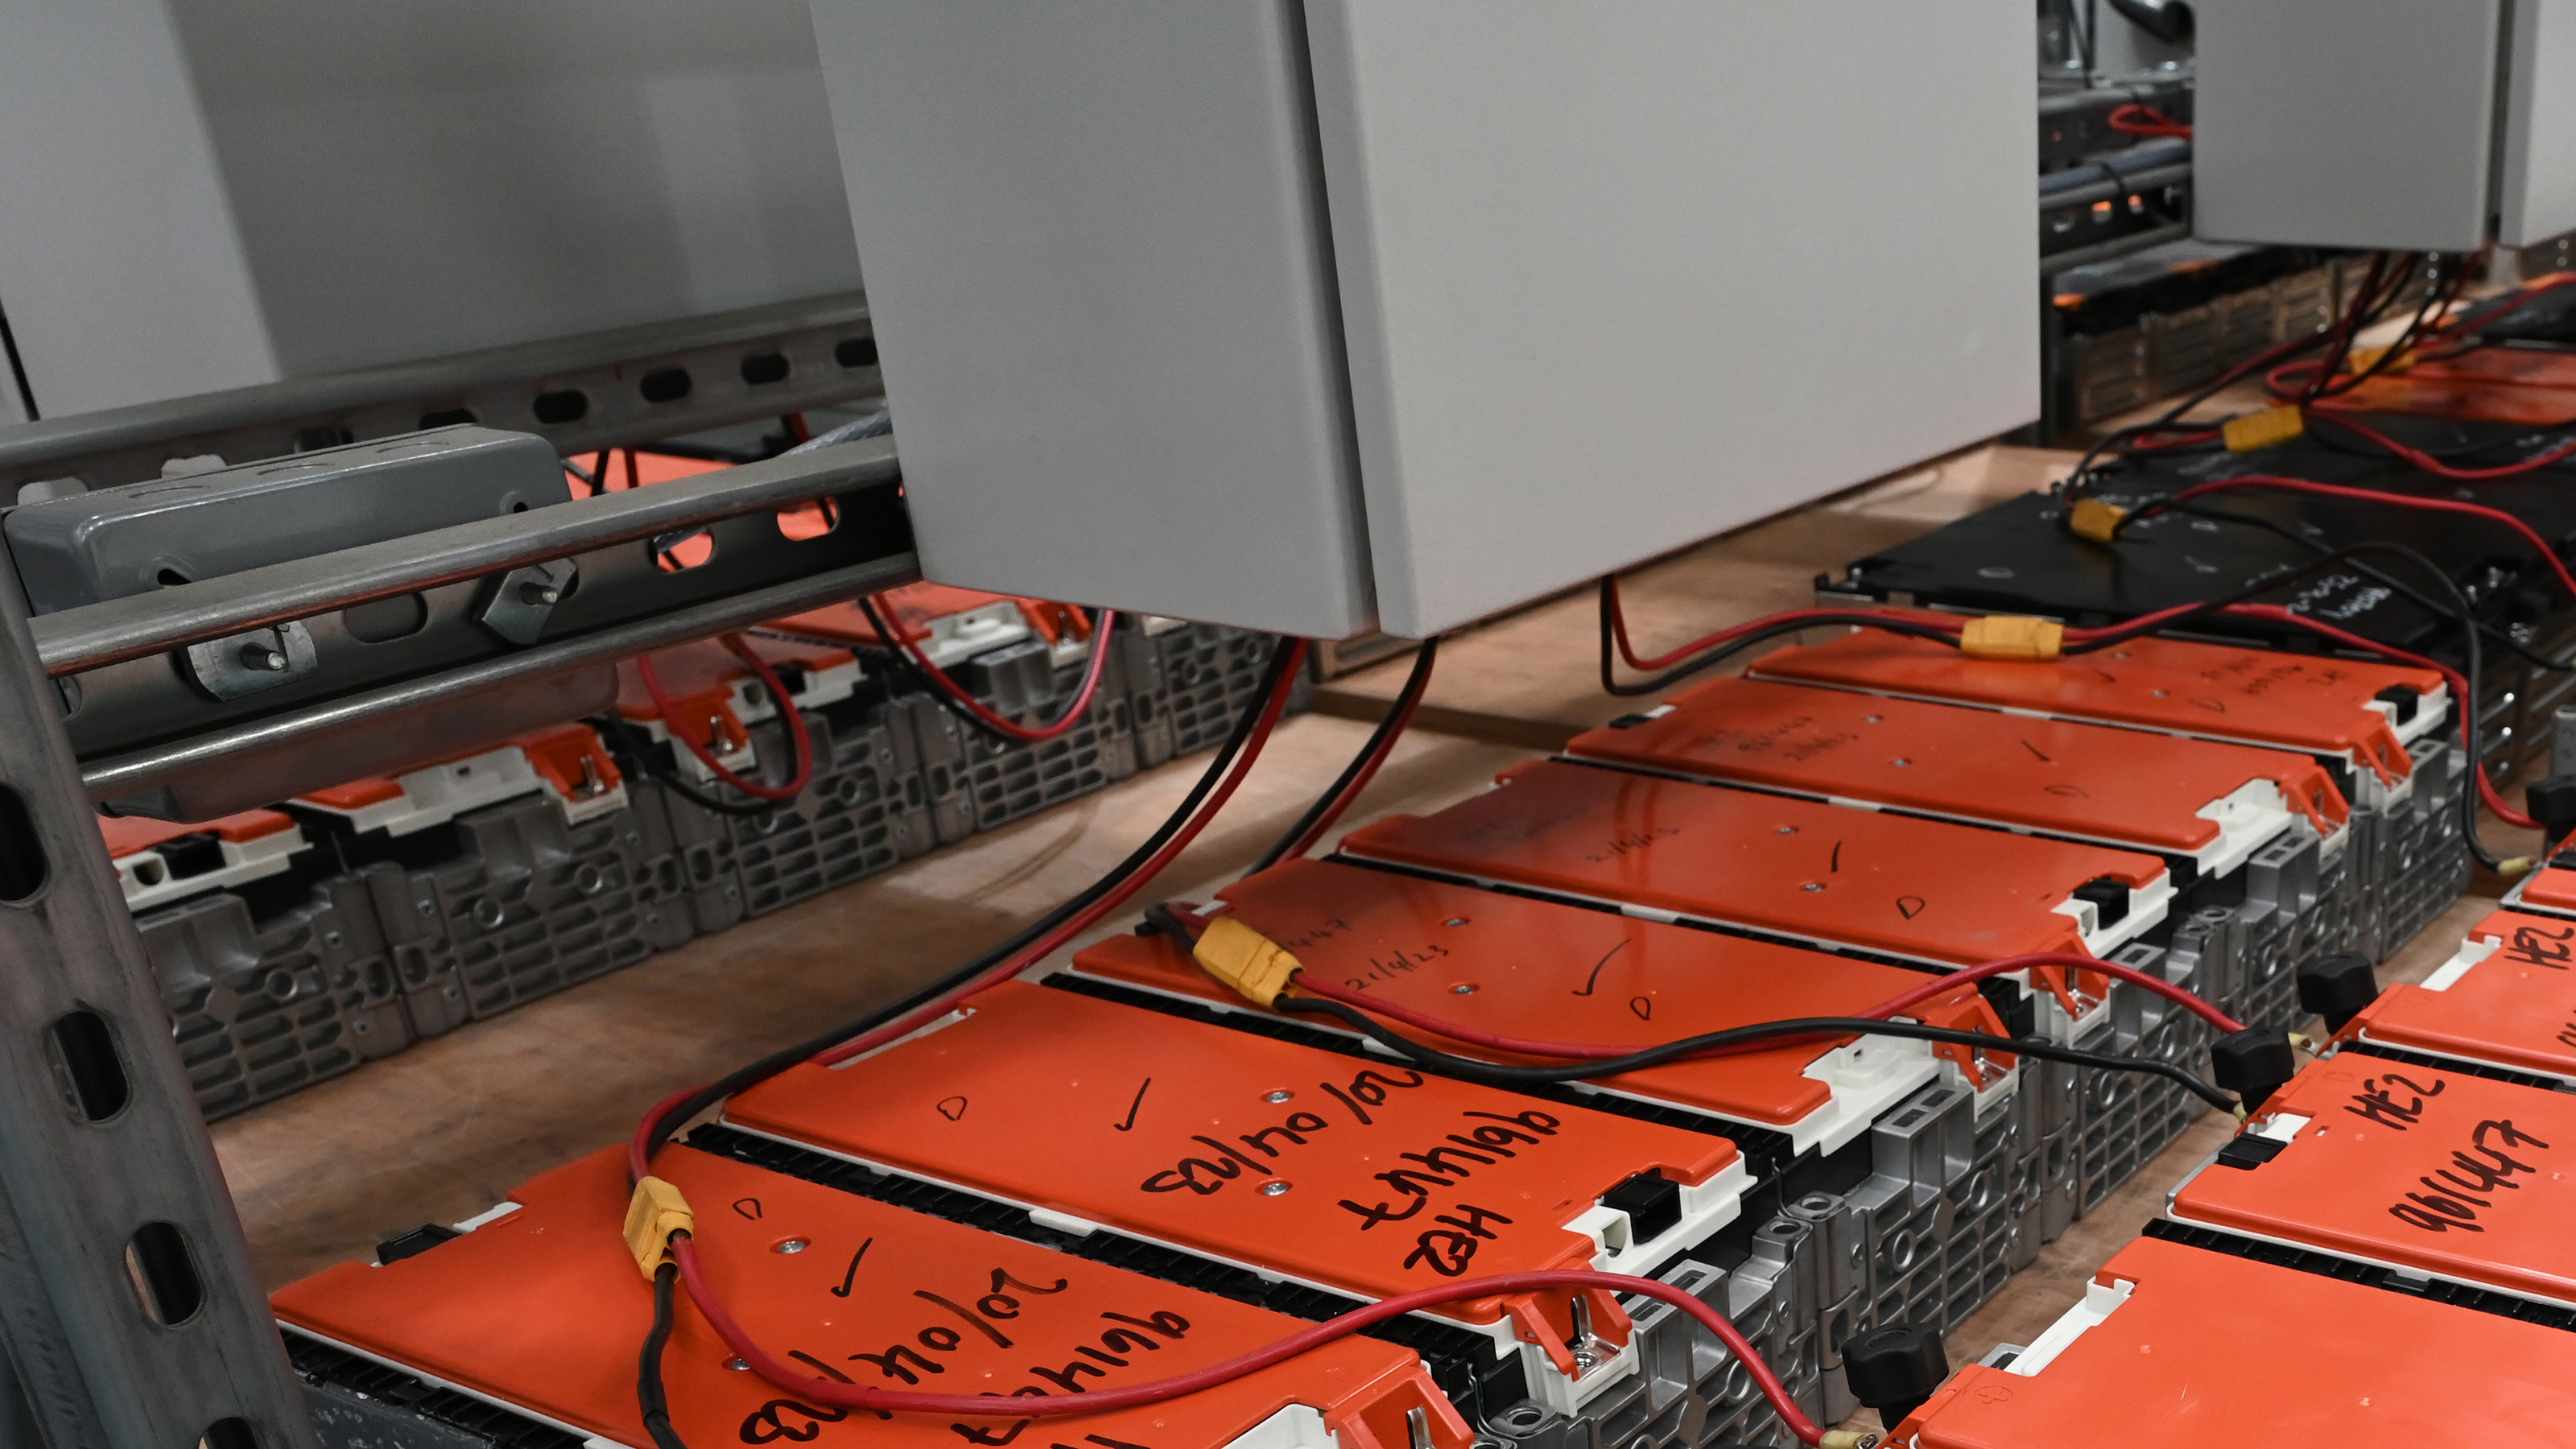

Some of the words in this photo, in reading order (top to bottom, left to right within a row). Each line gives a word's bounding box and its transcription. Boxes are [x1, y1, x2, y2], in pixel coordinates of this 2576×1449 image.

[1344, 945, 1449, 990] 21/4/23
[2344, 1073, 2446, 1131] HE2
[1337, 1110, 1562, 1232] 961447
[2388, 1119, 2549, 1233] 961447
[1403, 1202, 1513, 1278] HE2
[949, 1311, 1191, 1447] 96147
